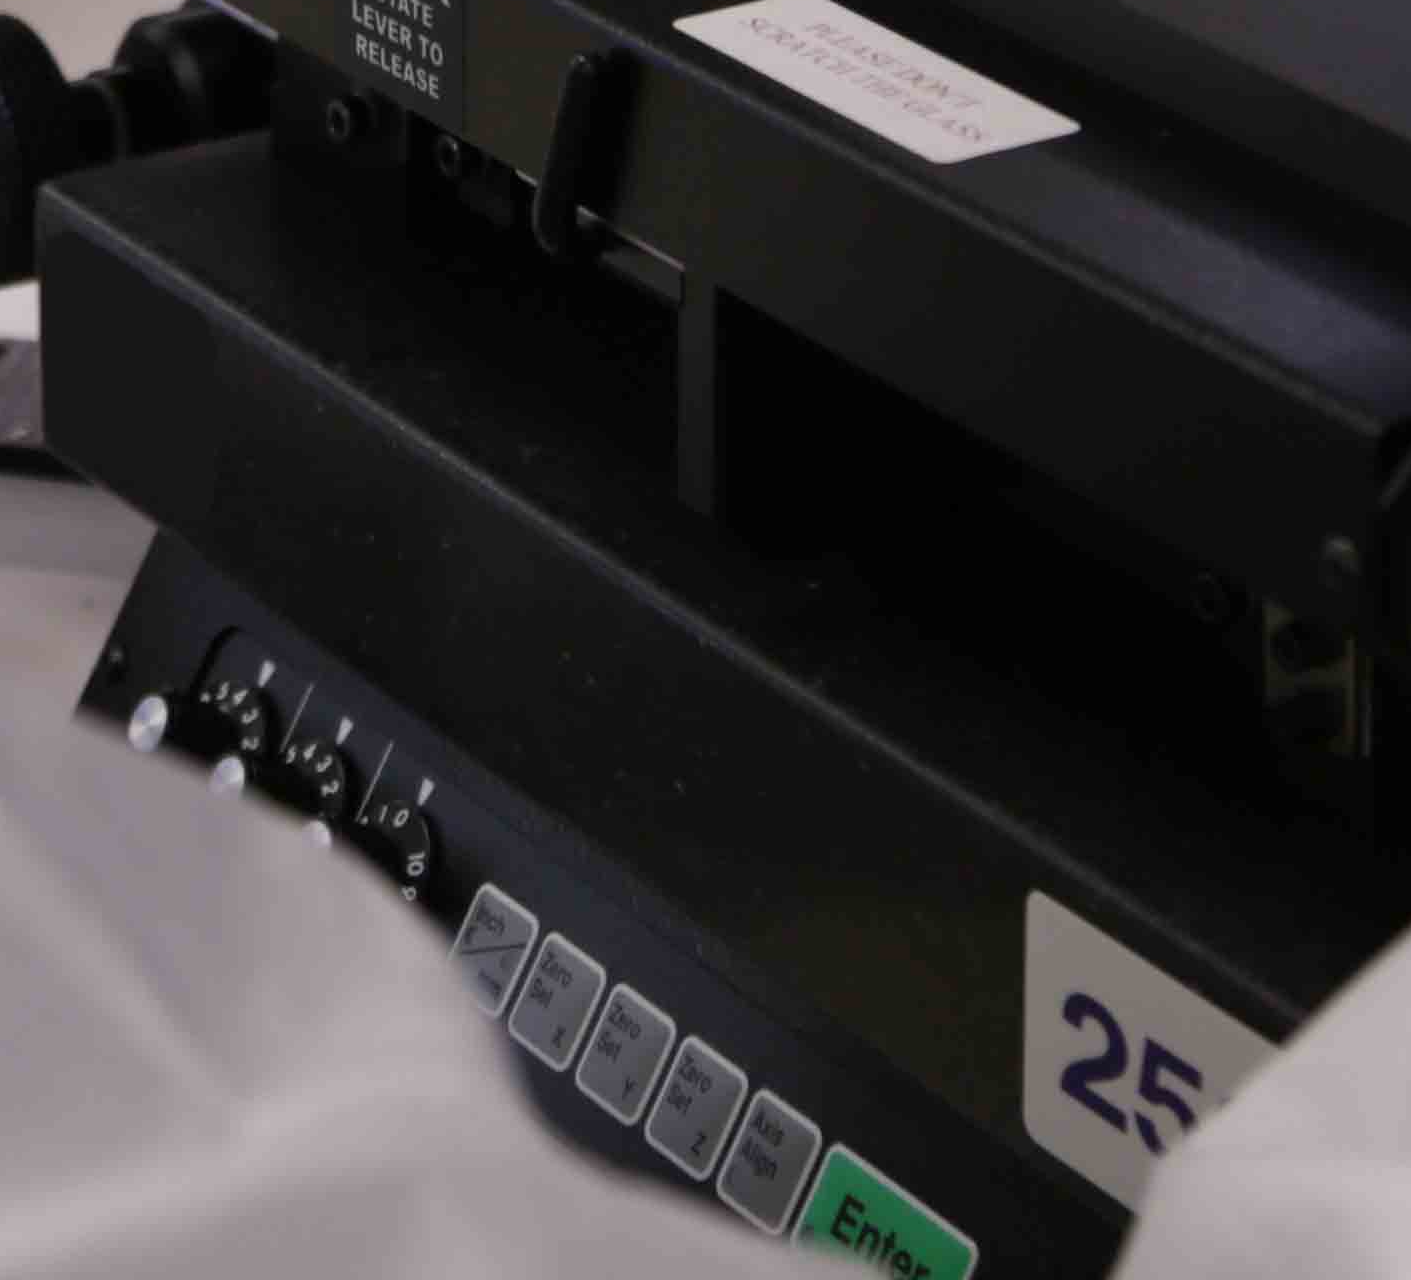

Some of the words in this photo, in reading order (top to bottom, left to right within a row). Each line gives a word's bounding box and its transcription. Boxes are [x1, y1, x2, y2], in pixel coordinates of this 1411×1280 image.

[355, 32, 439, 100] RELEASE
[418, 33, 443, 67] TO
[540, 950, 574, 989] Zero
[607, 1003, 642, 1041] Zero
[678, 1054, 712, 1094] Zero
[829, 1192, 932, 1280] Enter
